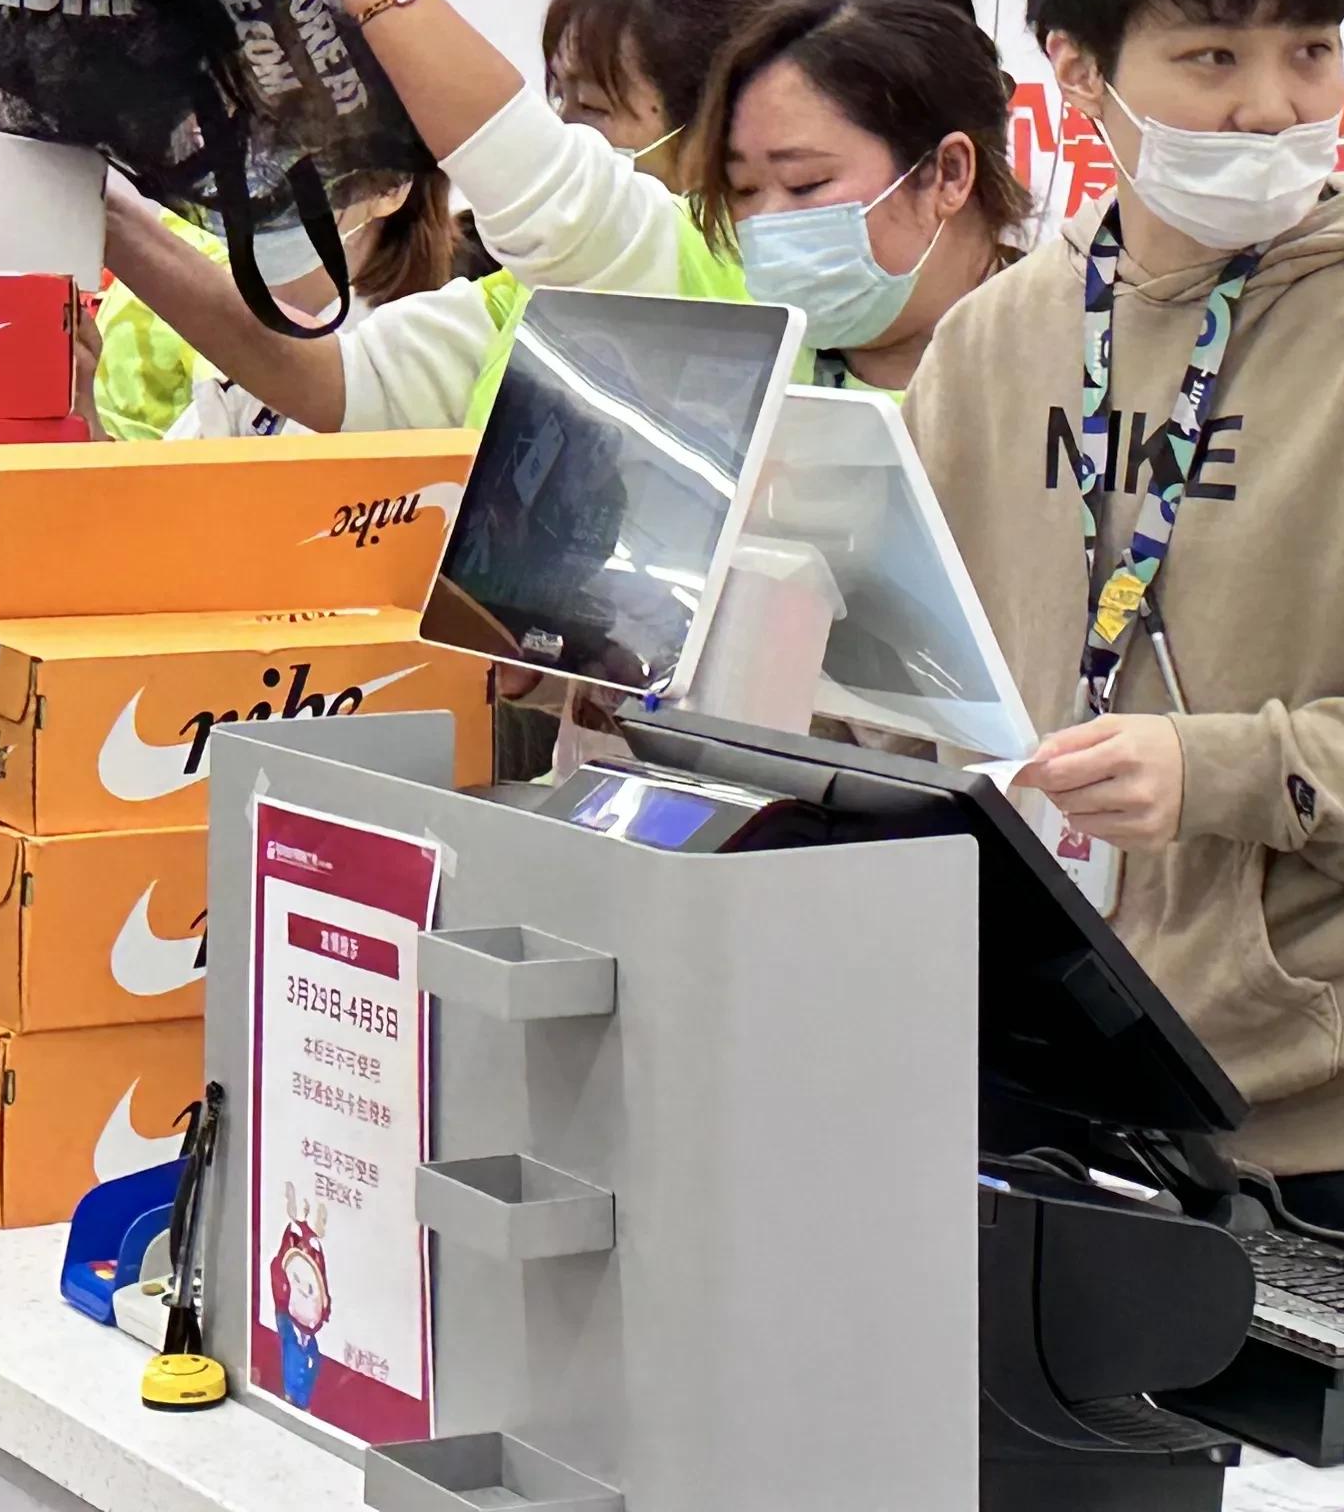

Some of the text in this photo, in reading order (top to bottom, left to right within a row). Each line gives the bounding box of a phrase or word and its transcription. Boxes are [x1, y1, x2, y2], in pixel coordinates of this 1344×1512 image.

[321, 67, 368, 116] AT
[1045, 405, 1244, 502] NIKE
[329, 492, 422, 548] nike
